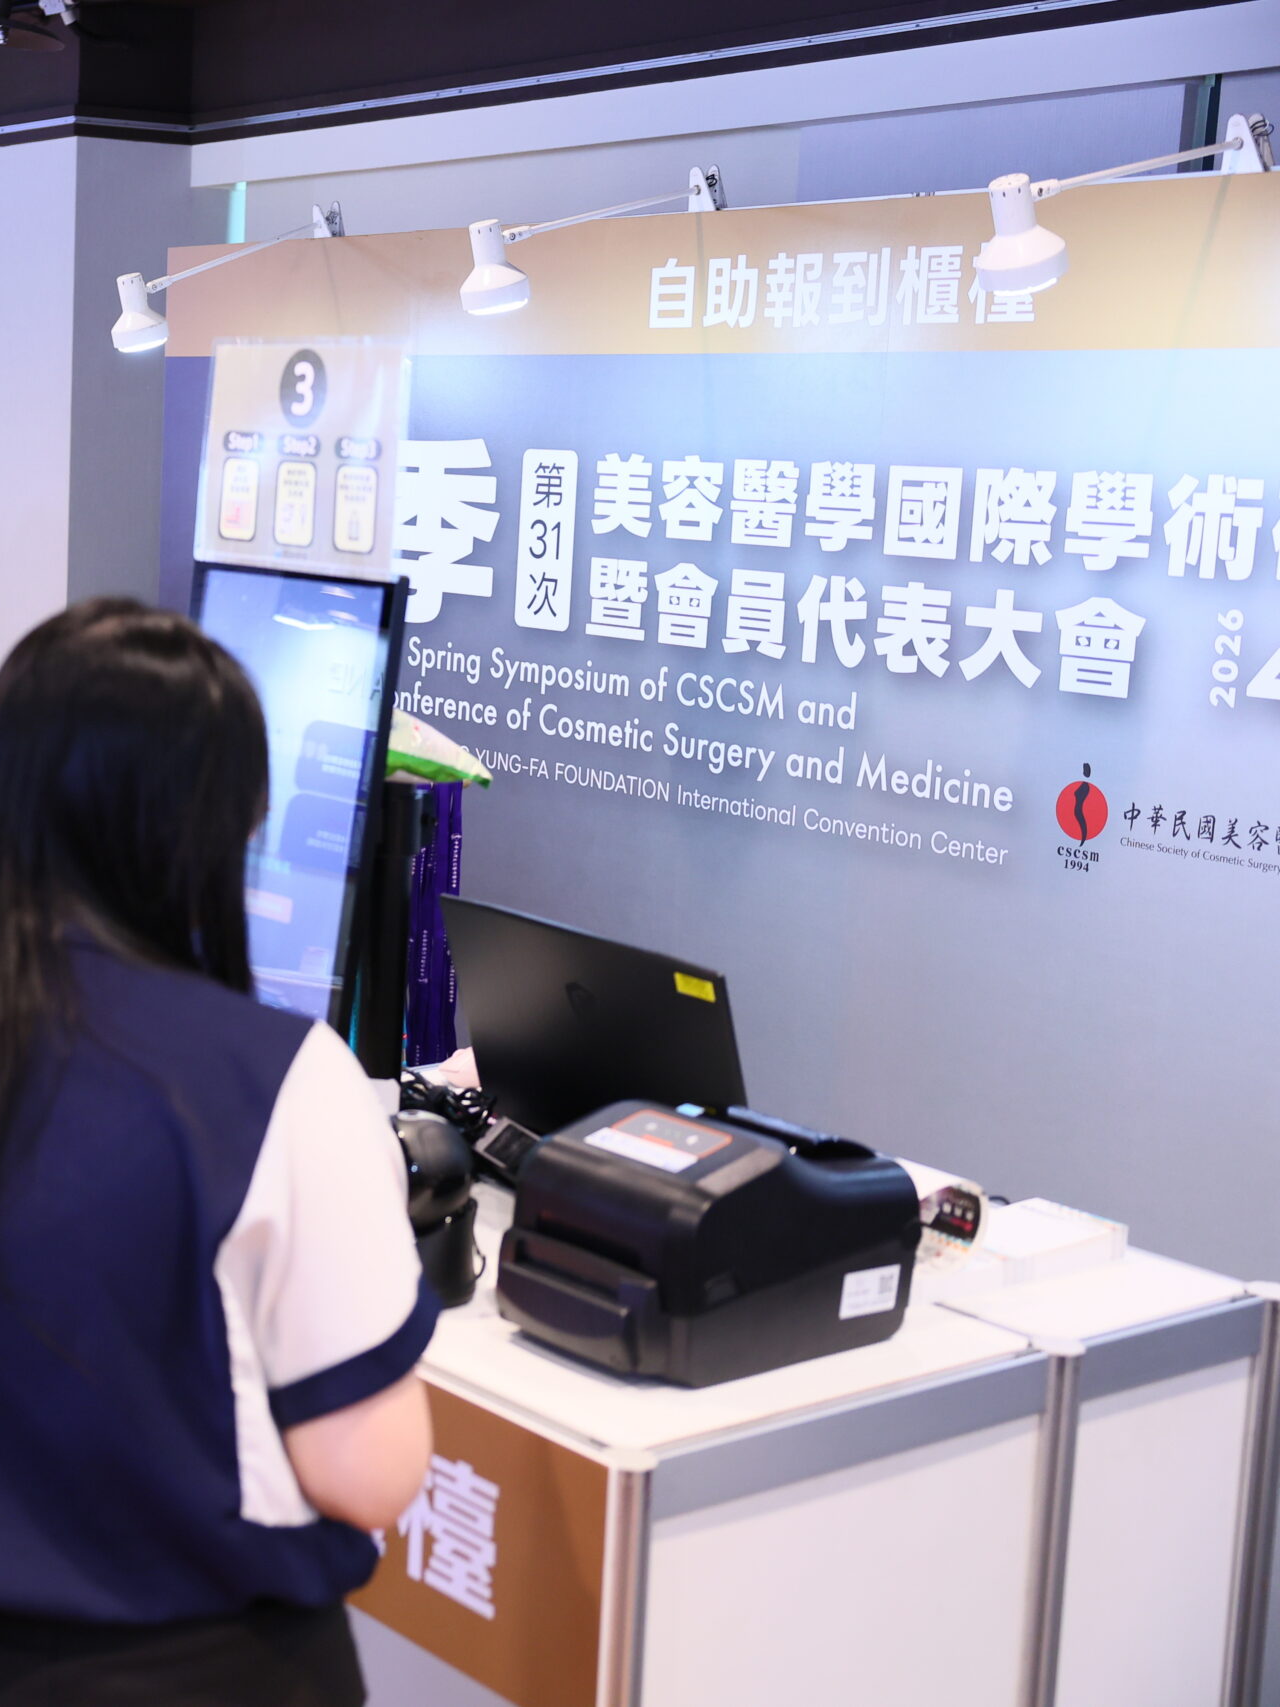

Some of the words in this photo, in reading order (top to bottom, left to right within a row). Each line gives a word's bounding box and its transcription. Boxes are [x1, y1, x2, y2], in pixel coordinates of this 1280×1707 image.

[648, 243, 1036, 328] 自助報到櫃
[289, 360, 316, 417] 3
[591, 452, 1280, 582] 美容醫學國際學術
[584, 555, 1147, 699] 暨會員代表大會
[1208, 608, 1245, 709] 2026
[407, 635, 482, 685] Spring
[490, 646, 630, 697] Symposium
[640, 665, 669, 702] of
[676, 671, 785, 720] CSCSM
[797, 691, 858, 731] and
[506, 698, 532, 732] of
[538, 703, 654, 753] Cosmetic
[663, 722, 776, 782] Surgery
[785, 746, 846, 785] and
[855, 750, 1014, 812] Medicine
[474, 746, 550, 780] YUNG-FA
[554, 761, 670, 803] FOUNDATION
[677, 784, 797, 828] International
[803, 808, 922, 850] Convention
[930, 830, 1009, 866] Center
[1123, 801, 1280, 856] 中華民國美容
[1056, 845, 1100, 863] cscsm
[1063, 858, 1090, 873] 1994
[1119, 837, 1155, 853] Chinese
[1156, 842, 1189, 859] Society
[1191, 849, 1202, 860] of
[1202, 851, 1246, 868] Cosmetic
[1247, 858, 1280, 875] Surgery
